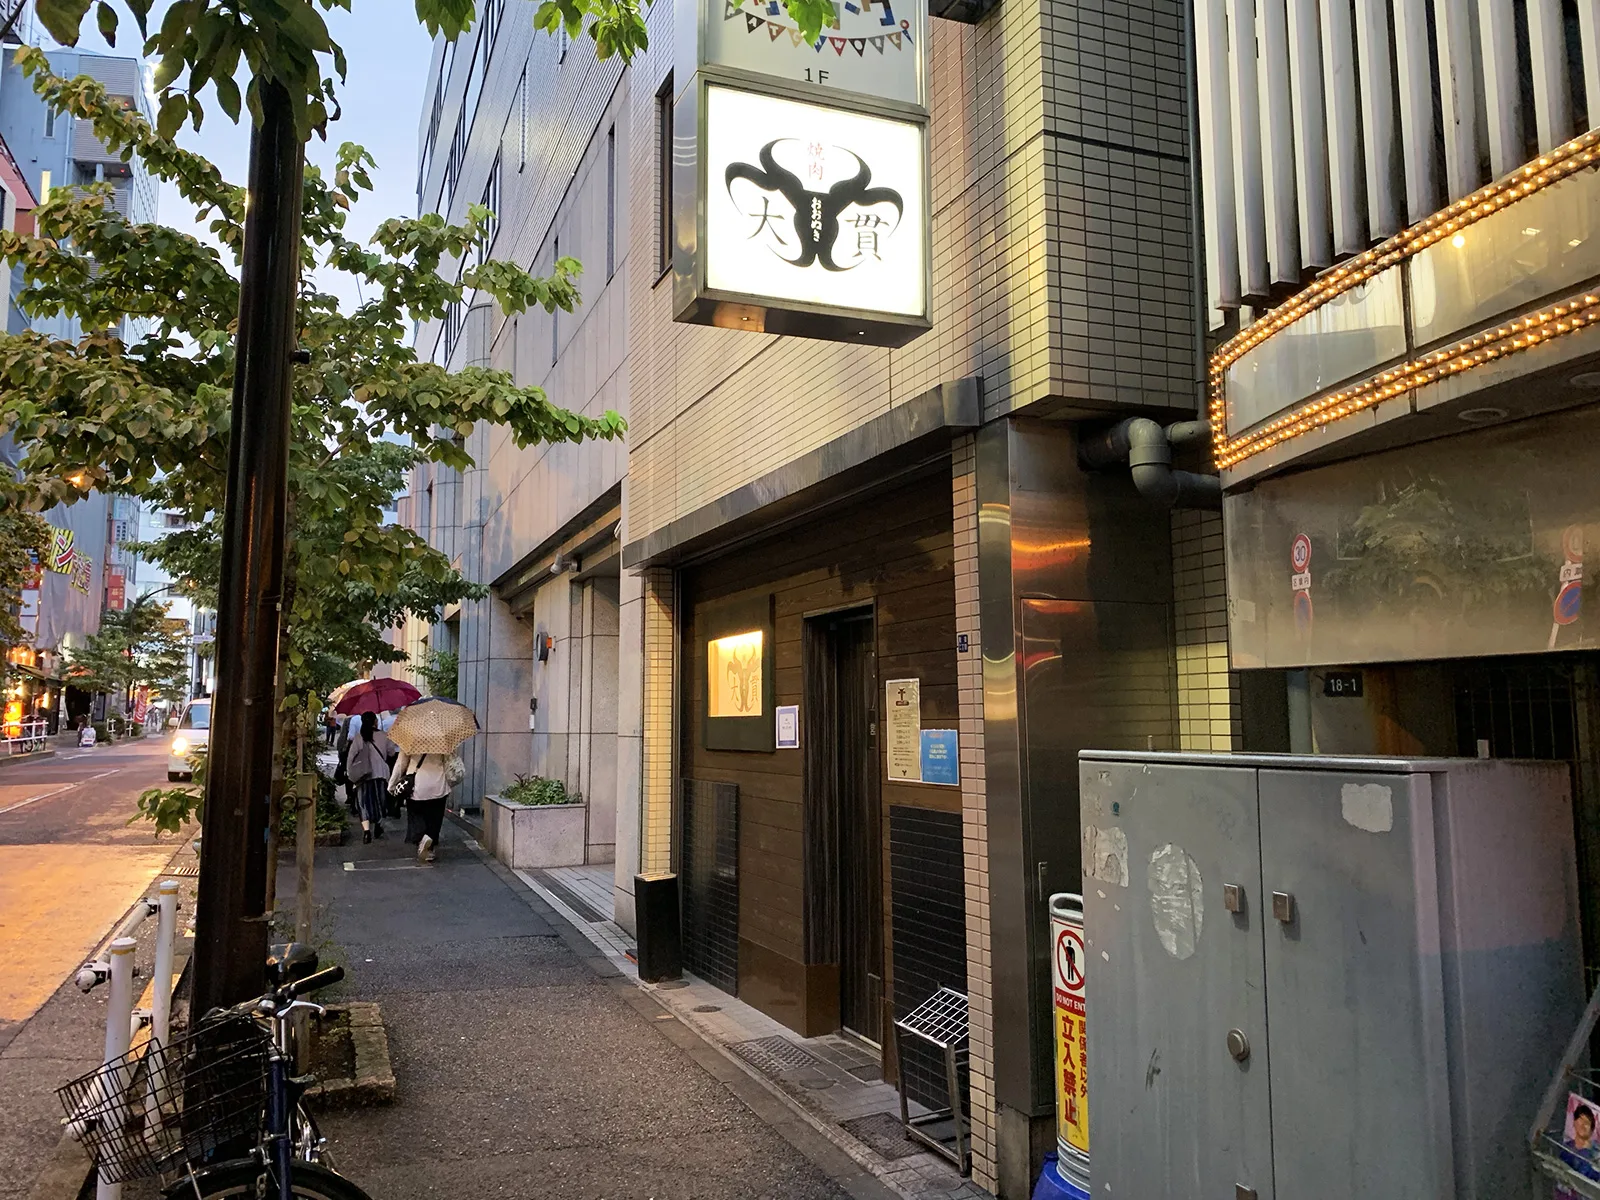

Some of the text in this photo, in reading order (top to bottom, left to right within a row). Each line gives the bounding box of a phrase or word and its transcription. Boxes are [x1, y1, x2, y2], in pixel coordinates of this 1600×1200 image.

[804, 67, 829, 84] 1F
[807, 142, 825, 180] 焼肉
[747, 196, 890, 261] 大 貫
[810, 196, 823, 242] おおぬき
[1295, 545, 1306, 562] 30
[1330, 678, 1356, 692] 18-1
[1062, 995, 1073, 1009] NOT
[1073, 1000, 1086, 1012] ENT
[1062, 1015, 1078, 1126] 立入禁止
